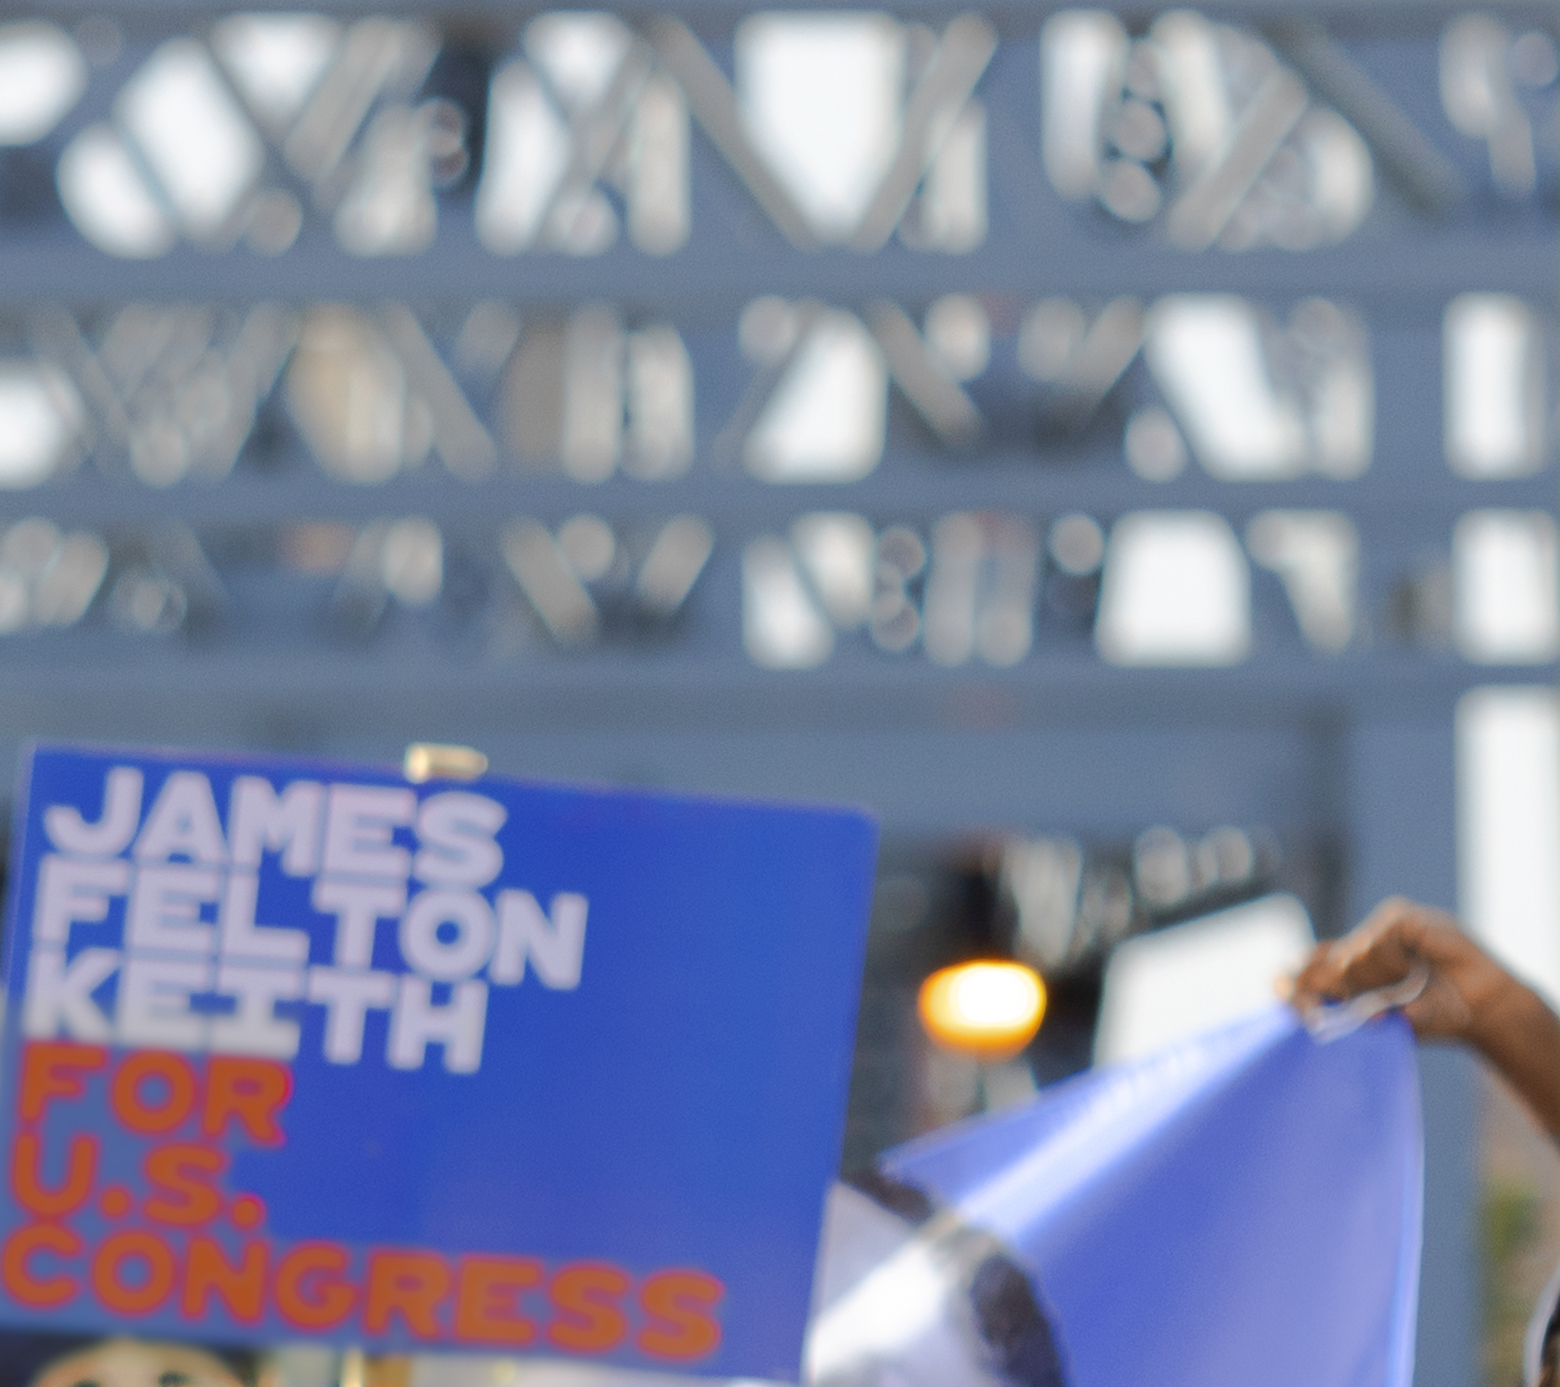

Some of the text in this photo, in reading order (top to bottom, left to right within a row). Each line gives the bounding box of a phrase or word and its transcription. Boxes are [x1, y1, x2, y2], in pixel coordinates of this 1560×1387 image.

[43, 766, 508, 888] JAMES
[32, 852, 590, 991] FELTON
[23, 944, 489, 1075] KEITH
[17, 1041, 294, 1147] FOR
[7, 1130, 265, 1232] U.S.
